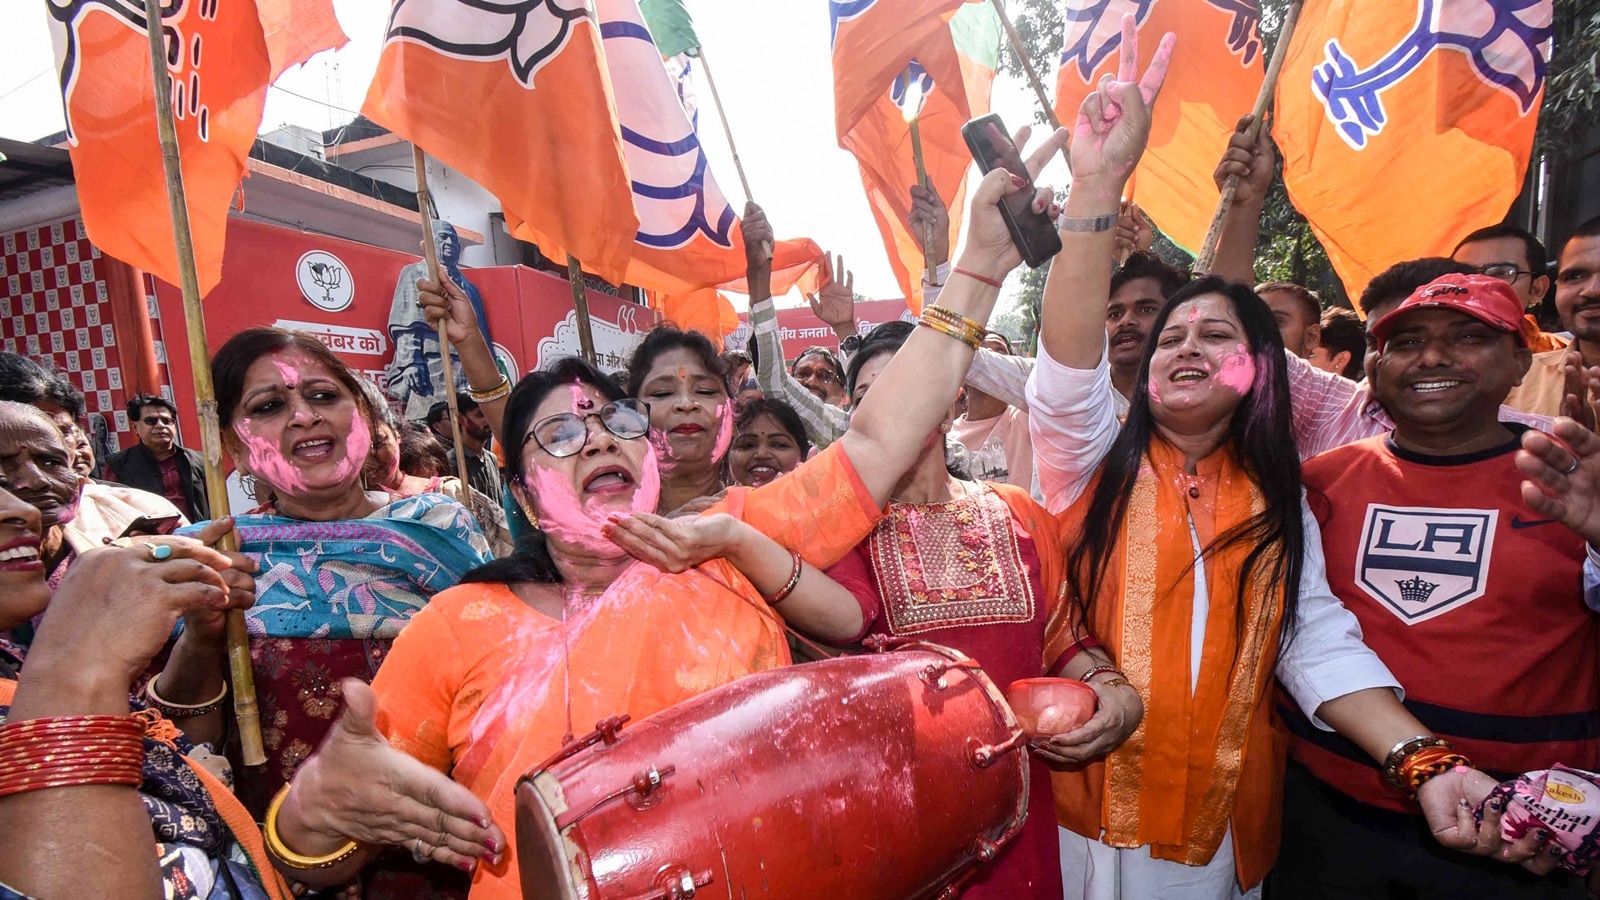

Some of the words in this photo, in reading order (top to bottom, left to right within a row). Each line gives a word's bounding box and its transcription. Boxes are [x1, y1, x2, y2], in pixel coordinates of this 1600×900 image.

[314, 328, 354, 350] वंबर
[358, 332, 380, 352] को
[798, 327, 828, 339] जनता
[606, 350, 620, 369] और
[1374, 518, 1478, 555] LA
